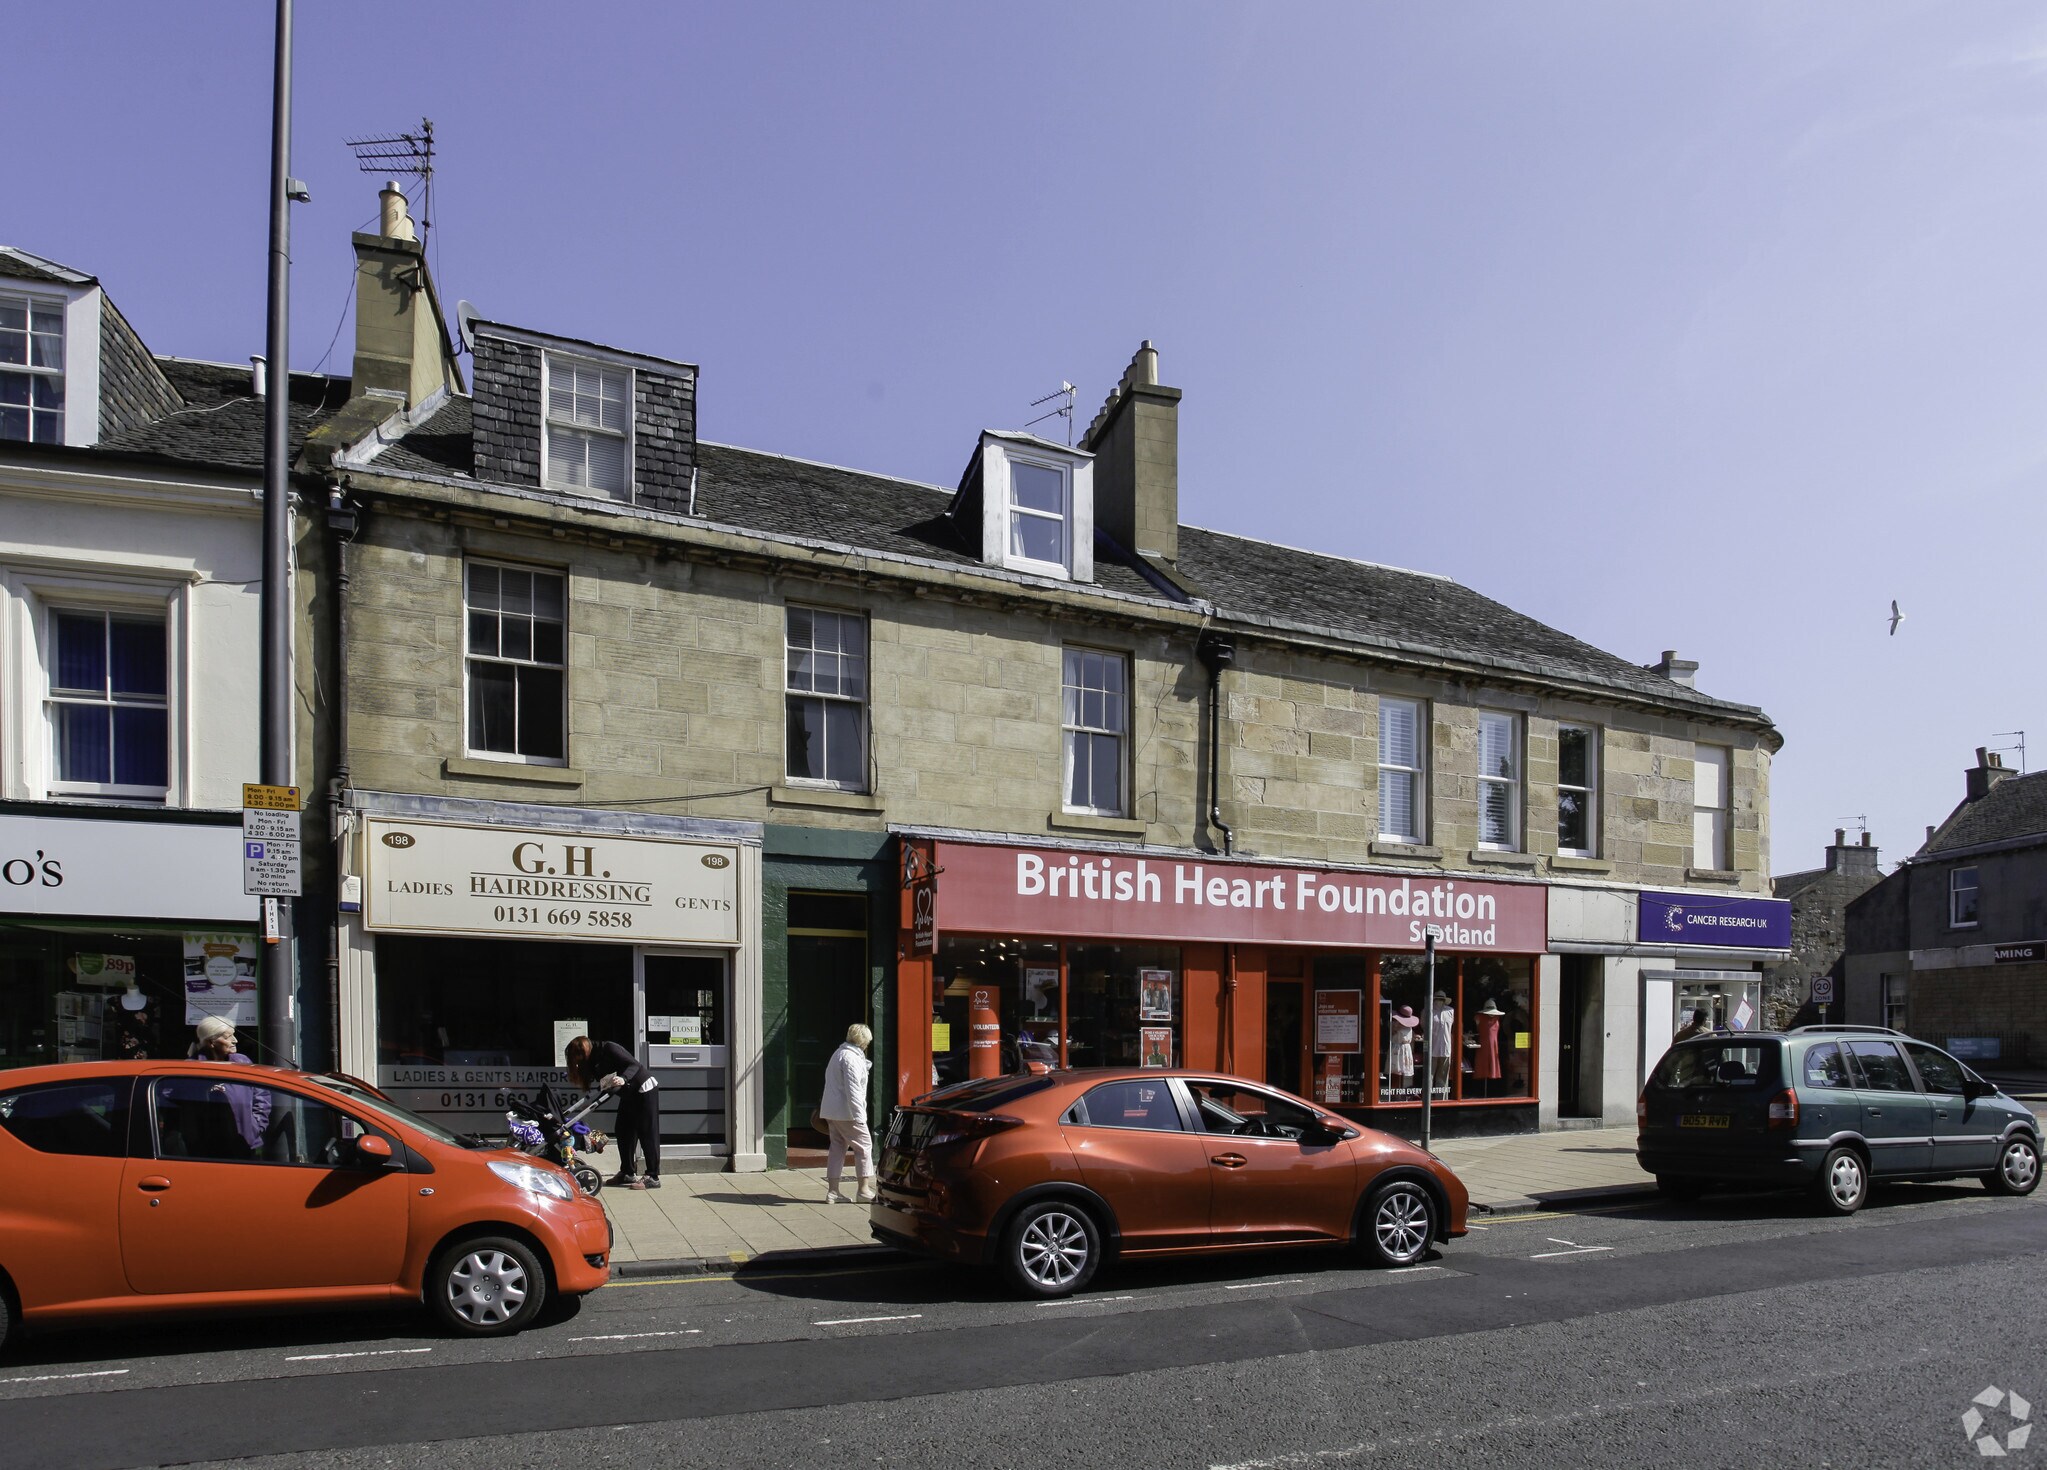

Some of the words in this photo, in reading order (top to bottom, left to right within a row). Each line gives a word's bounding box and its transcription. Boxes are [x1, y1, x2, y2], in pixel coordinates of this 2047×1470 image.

[389, 835, 409, 845] 198
[251, 845, 261, 857] P
[706, 856, 723, 866] 198
[388, 880, 453, 896] LADIES
[469, 876, 651, 902] HAIRDRESSING
[1017, 853, 1161, 902] British
[1175, 864, 1286, 910] Heart
[1296, 873, 1496, 920] Foundation
[675, 897, 731, 911] GENTS
[494, 905, 539, 923] 0131
[547, 908, 581, 925] 669
[587, 910, 632, 928] 5858
[1687, 914, 1717, 926] CANCER
[1719, 916, 1756, 928] RESEARCH
[1757, 919, 1767, 928] UK
[1816, 983, 1829, 991] 20
[394, 1071, 446, 1082] LADIES
[450, 1071, 460, 1082] &
[465, 1071, 512, 1083] GENTS
[1430, 1086, 1451, 1094] ARTBEAT
[441, 1093, 485, 1107] 0131
